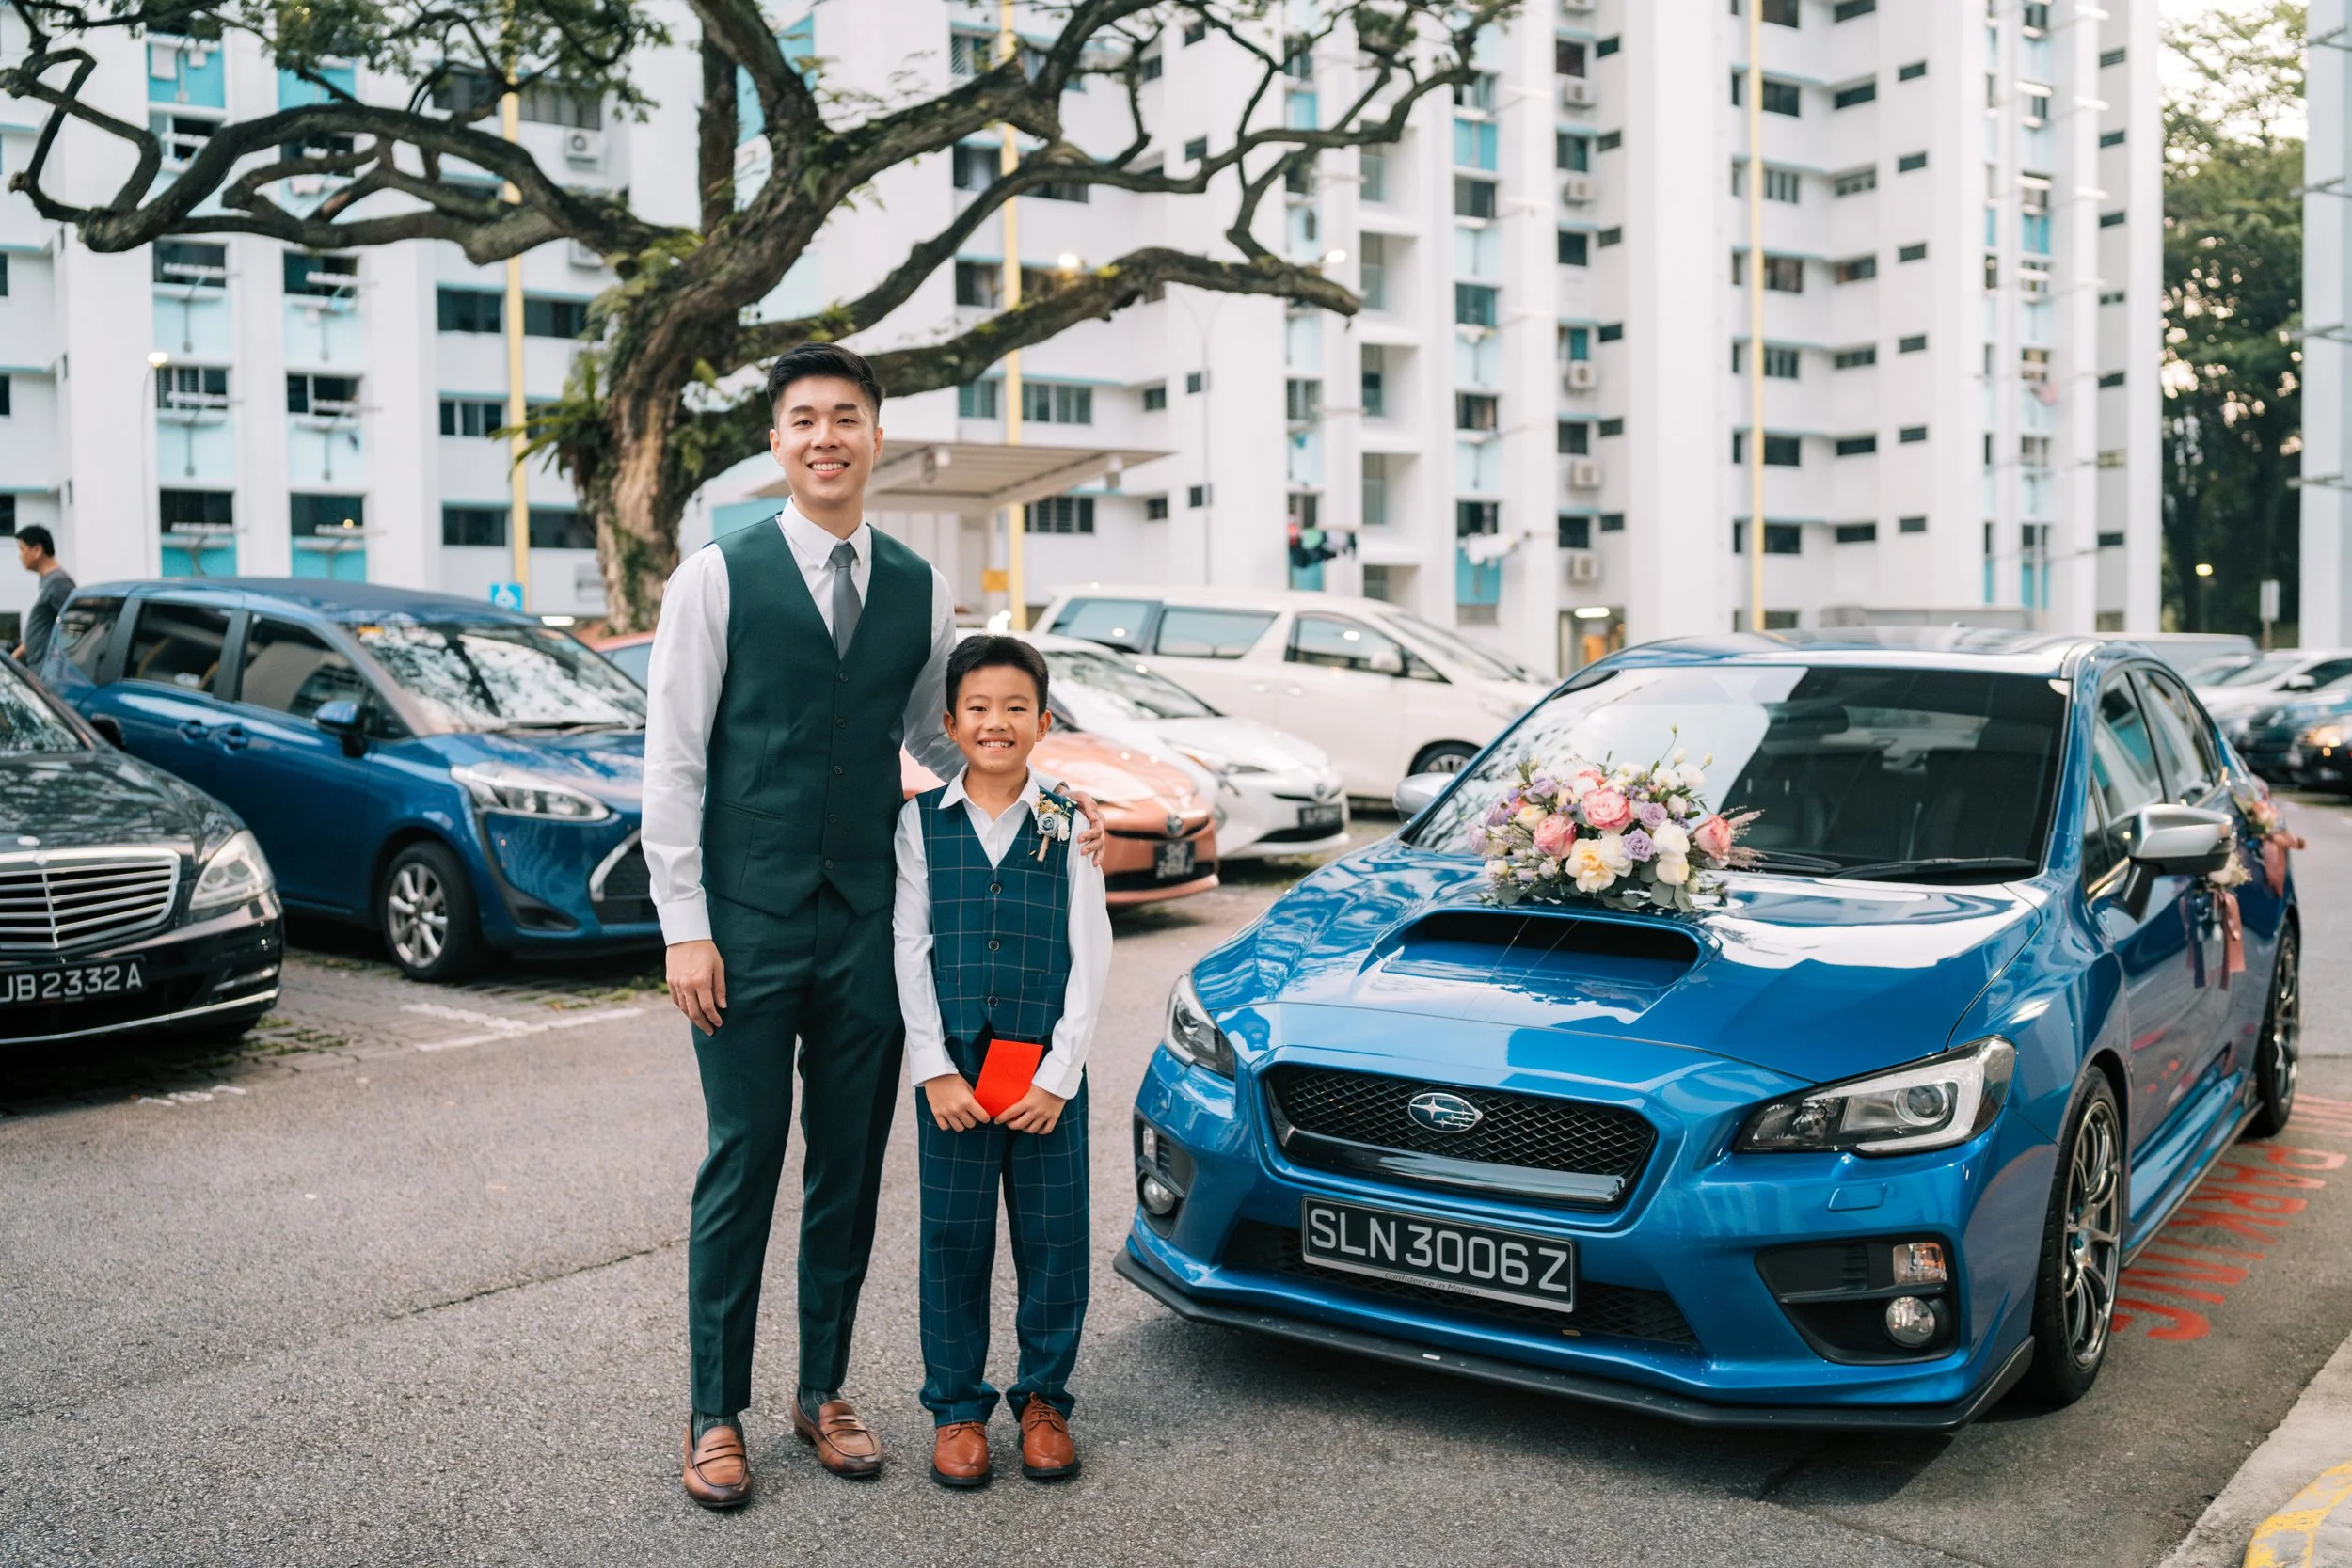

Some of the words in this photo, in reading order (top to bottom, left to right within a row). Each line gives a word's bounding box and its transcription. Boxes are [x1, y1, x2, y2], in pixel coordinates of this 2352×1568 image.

[42, 965, 121, 1000] 2332
[126, 962, 143, 989] A
[1310, 1208, 1396, 1261] SLN
[1406, 1224, 1529, 1286] 3006
[1537, 1247, 1568, 1293] Z
[1384, 1271, 1434, 1287] Confidence
[1447, 1283, 1479, 1295] Motion
